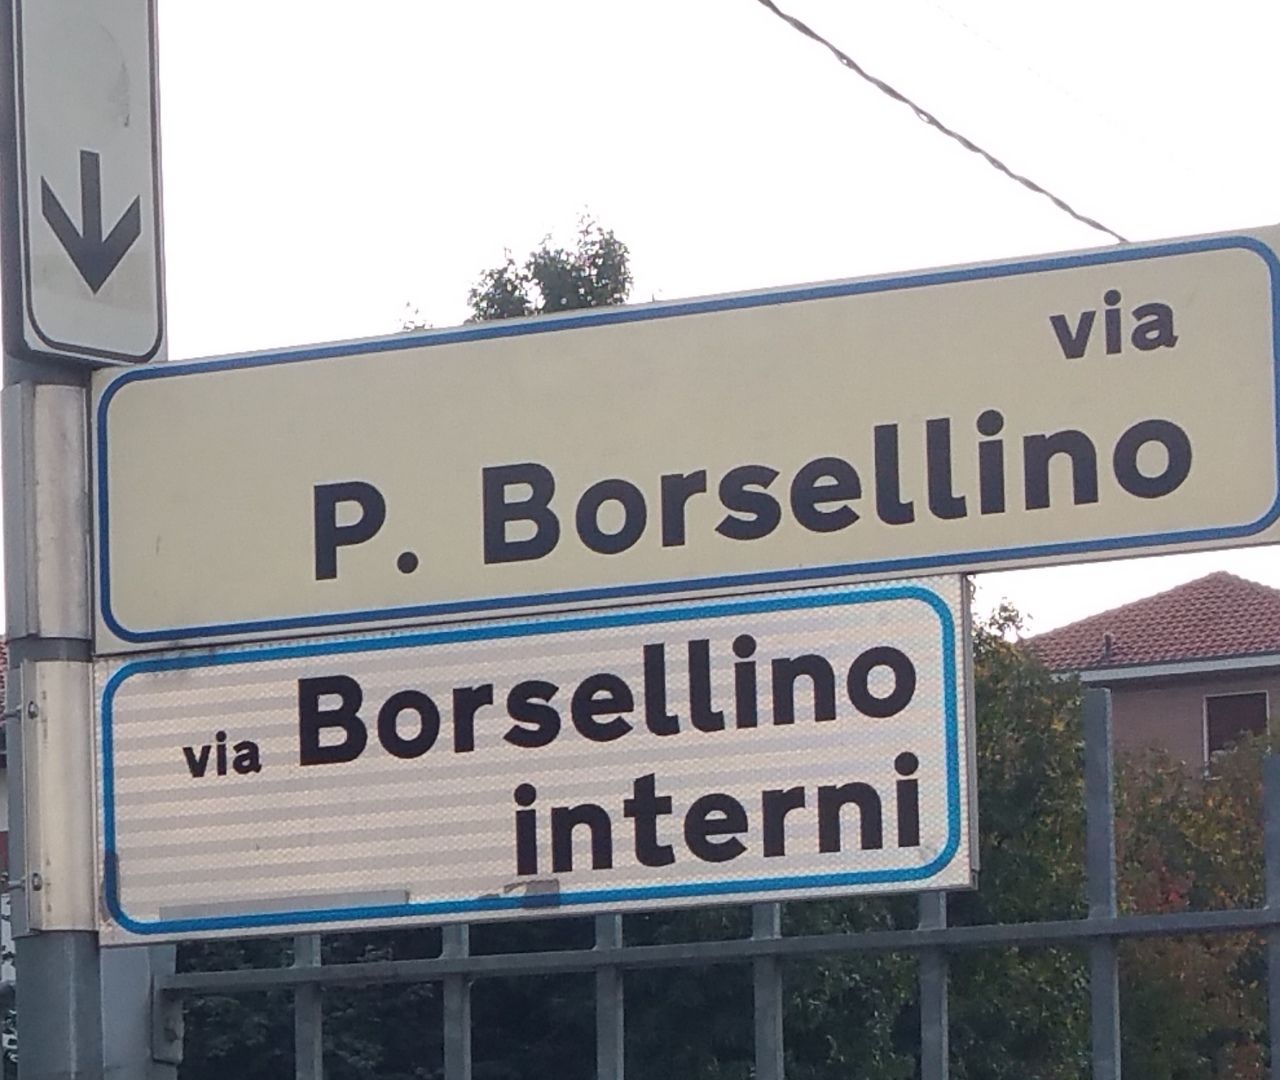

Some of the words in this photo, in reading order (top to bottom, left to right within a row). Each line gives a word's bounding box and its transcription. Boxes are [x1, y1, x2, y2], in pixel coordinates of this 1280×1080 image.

[1049, 289, 1178, 359] via
[313, 481, 419, 581] P.
[482, 409, 1193, 565] Borsellino
[182, 730, 263, 779] via
[297, 634, 917, 767] Borsellino
[513, 751, 921, 876] interni
